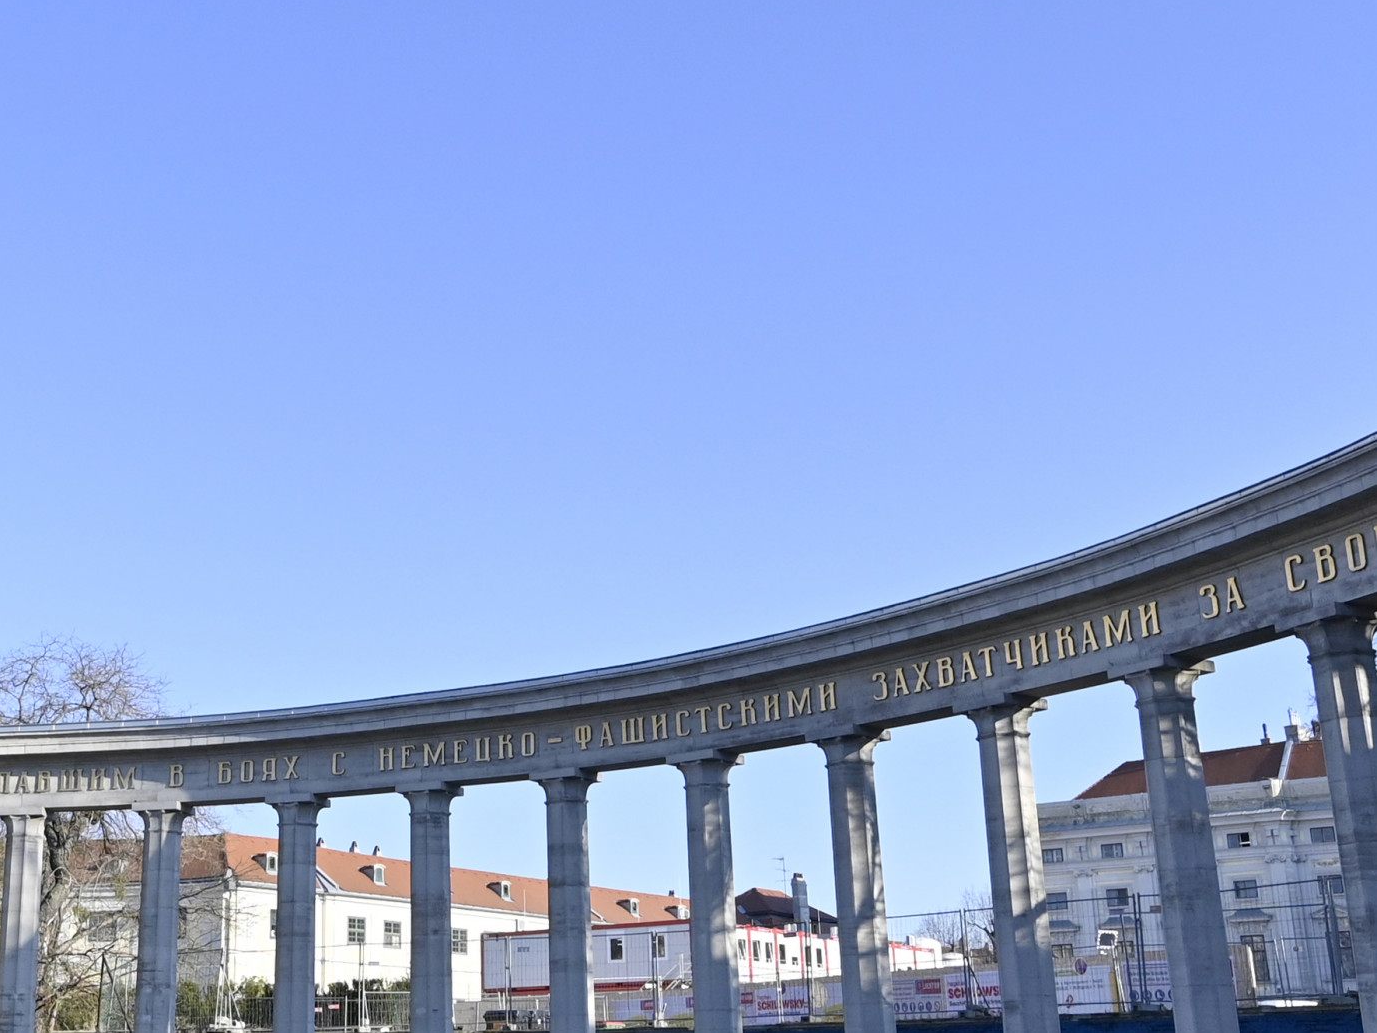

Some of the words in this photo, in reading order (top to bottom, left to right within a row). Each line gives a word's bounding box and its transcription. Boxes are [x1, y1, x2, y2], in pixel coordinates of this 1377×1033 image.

[168, 764, 184, 789] В
[217, 756, 301, 784] БОЯХ
[331, 751, 346, 776] С
[872, 600, 1161, 702] ЗАХВАТЧИКАМИ
[1199, 576, 1246, 619] ЗА
[1284, 526, 1377, 592] СВО
